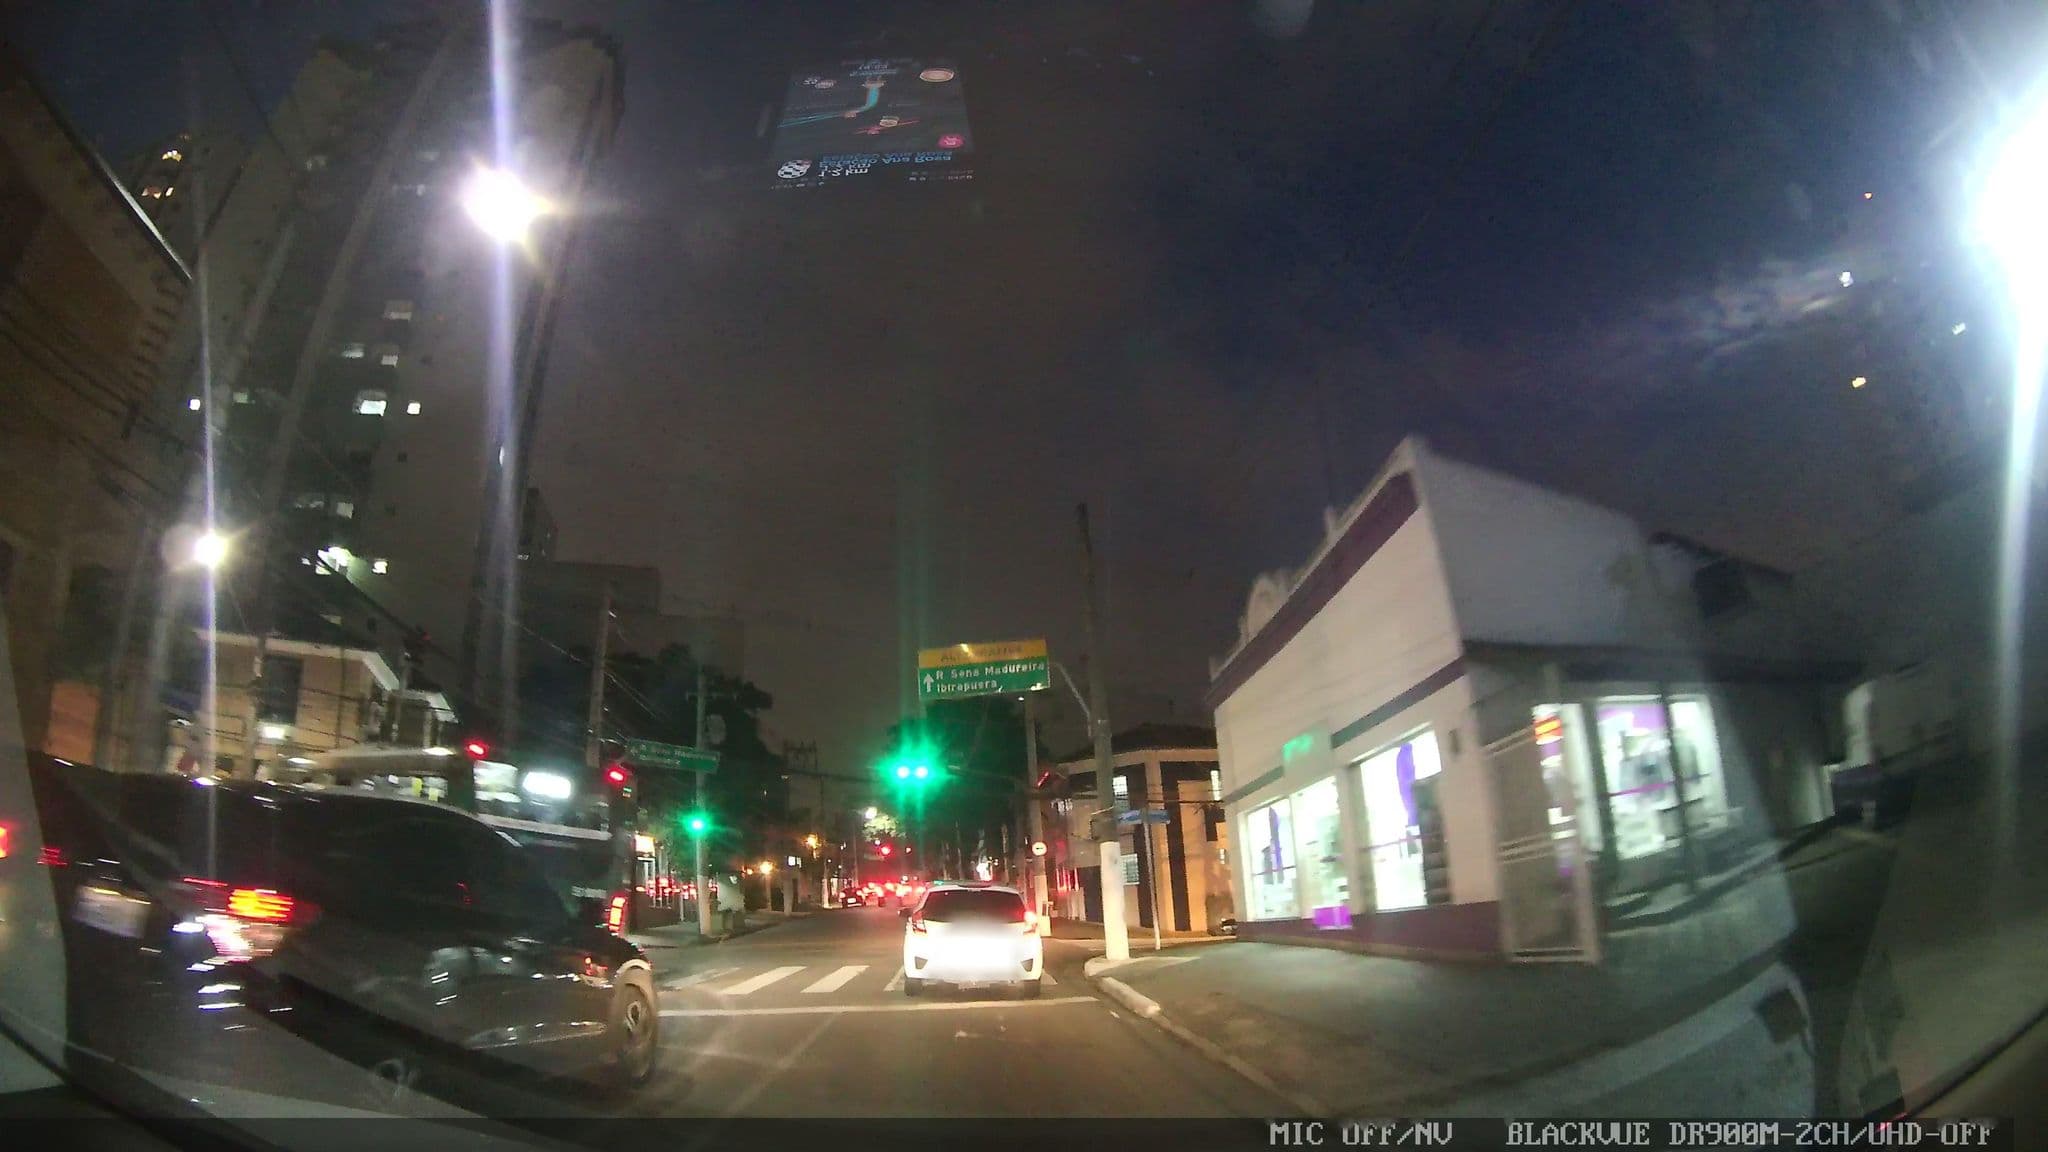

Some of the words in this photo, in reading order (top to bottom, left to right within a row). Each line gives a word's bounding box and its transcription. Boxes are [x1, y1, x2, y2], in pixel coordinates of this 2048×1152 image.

[936, 670, 944, 680] R
[951, 668, 980, 679] Sena
[984, 661, 1045, 677] Madureira
[936, 679, 998, 693] Ibirapuera
